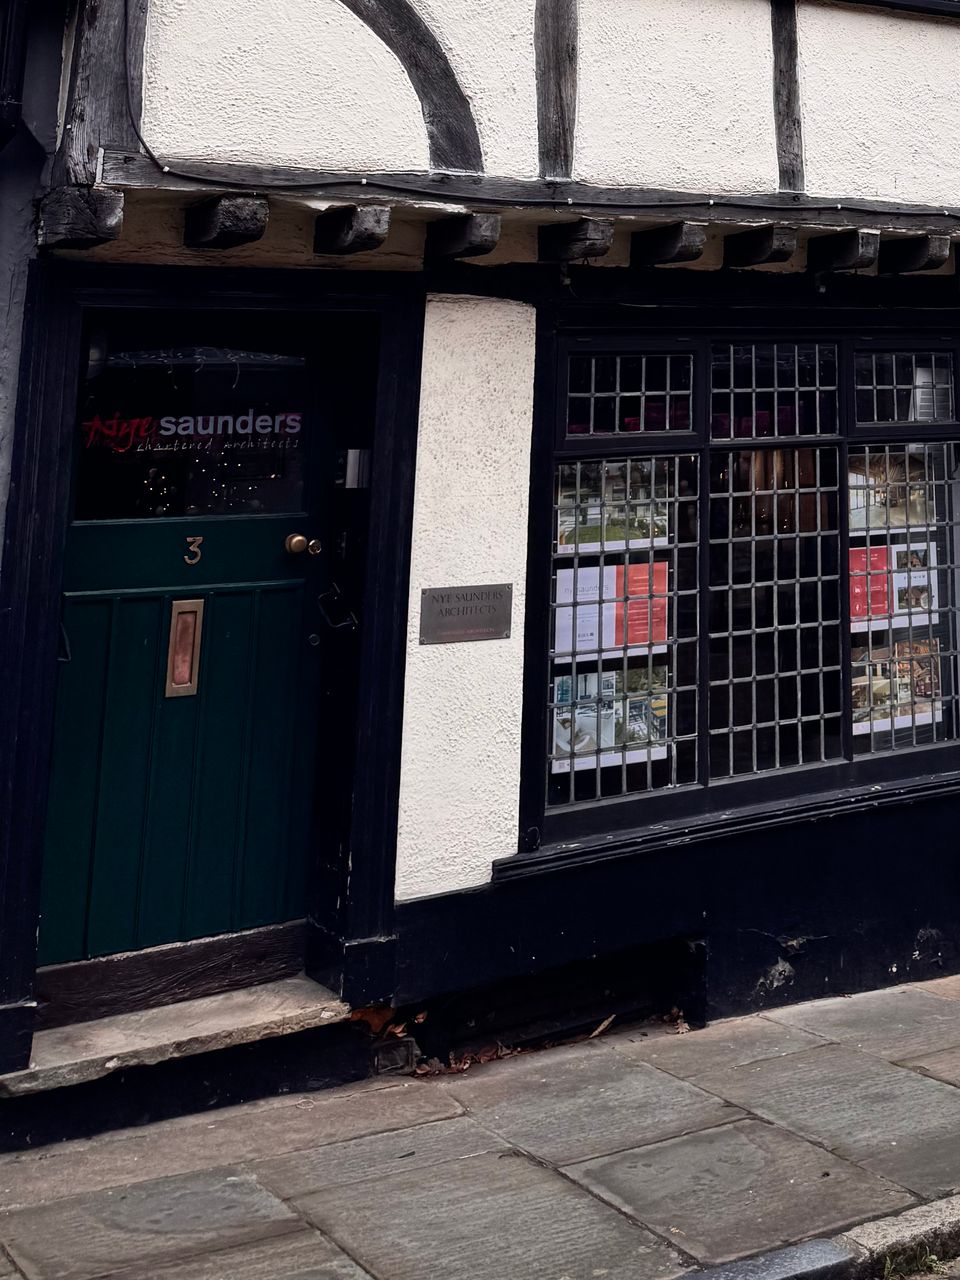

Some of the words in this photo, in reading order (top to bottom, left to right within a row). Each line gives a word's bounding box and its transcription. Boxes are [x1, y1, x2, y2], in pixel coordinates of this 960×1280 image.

[159, 409, 302, 436] saunders
[137, 438, 213, 452] chartered
[224, 438, 299, 449] architects
[184, 536, 203, 565] 3
[432, 593, 451, 604] NYE
[455, 591, 504, 602] SAUNDERS
[439, 605, 497, 617] ARCHITECTS
